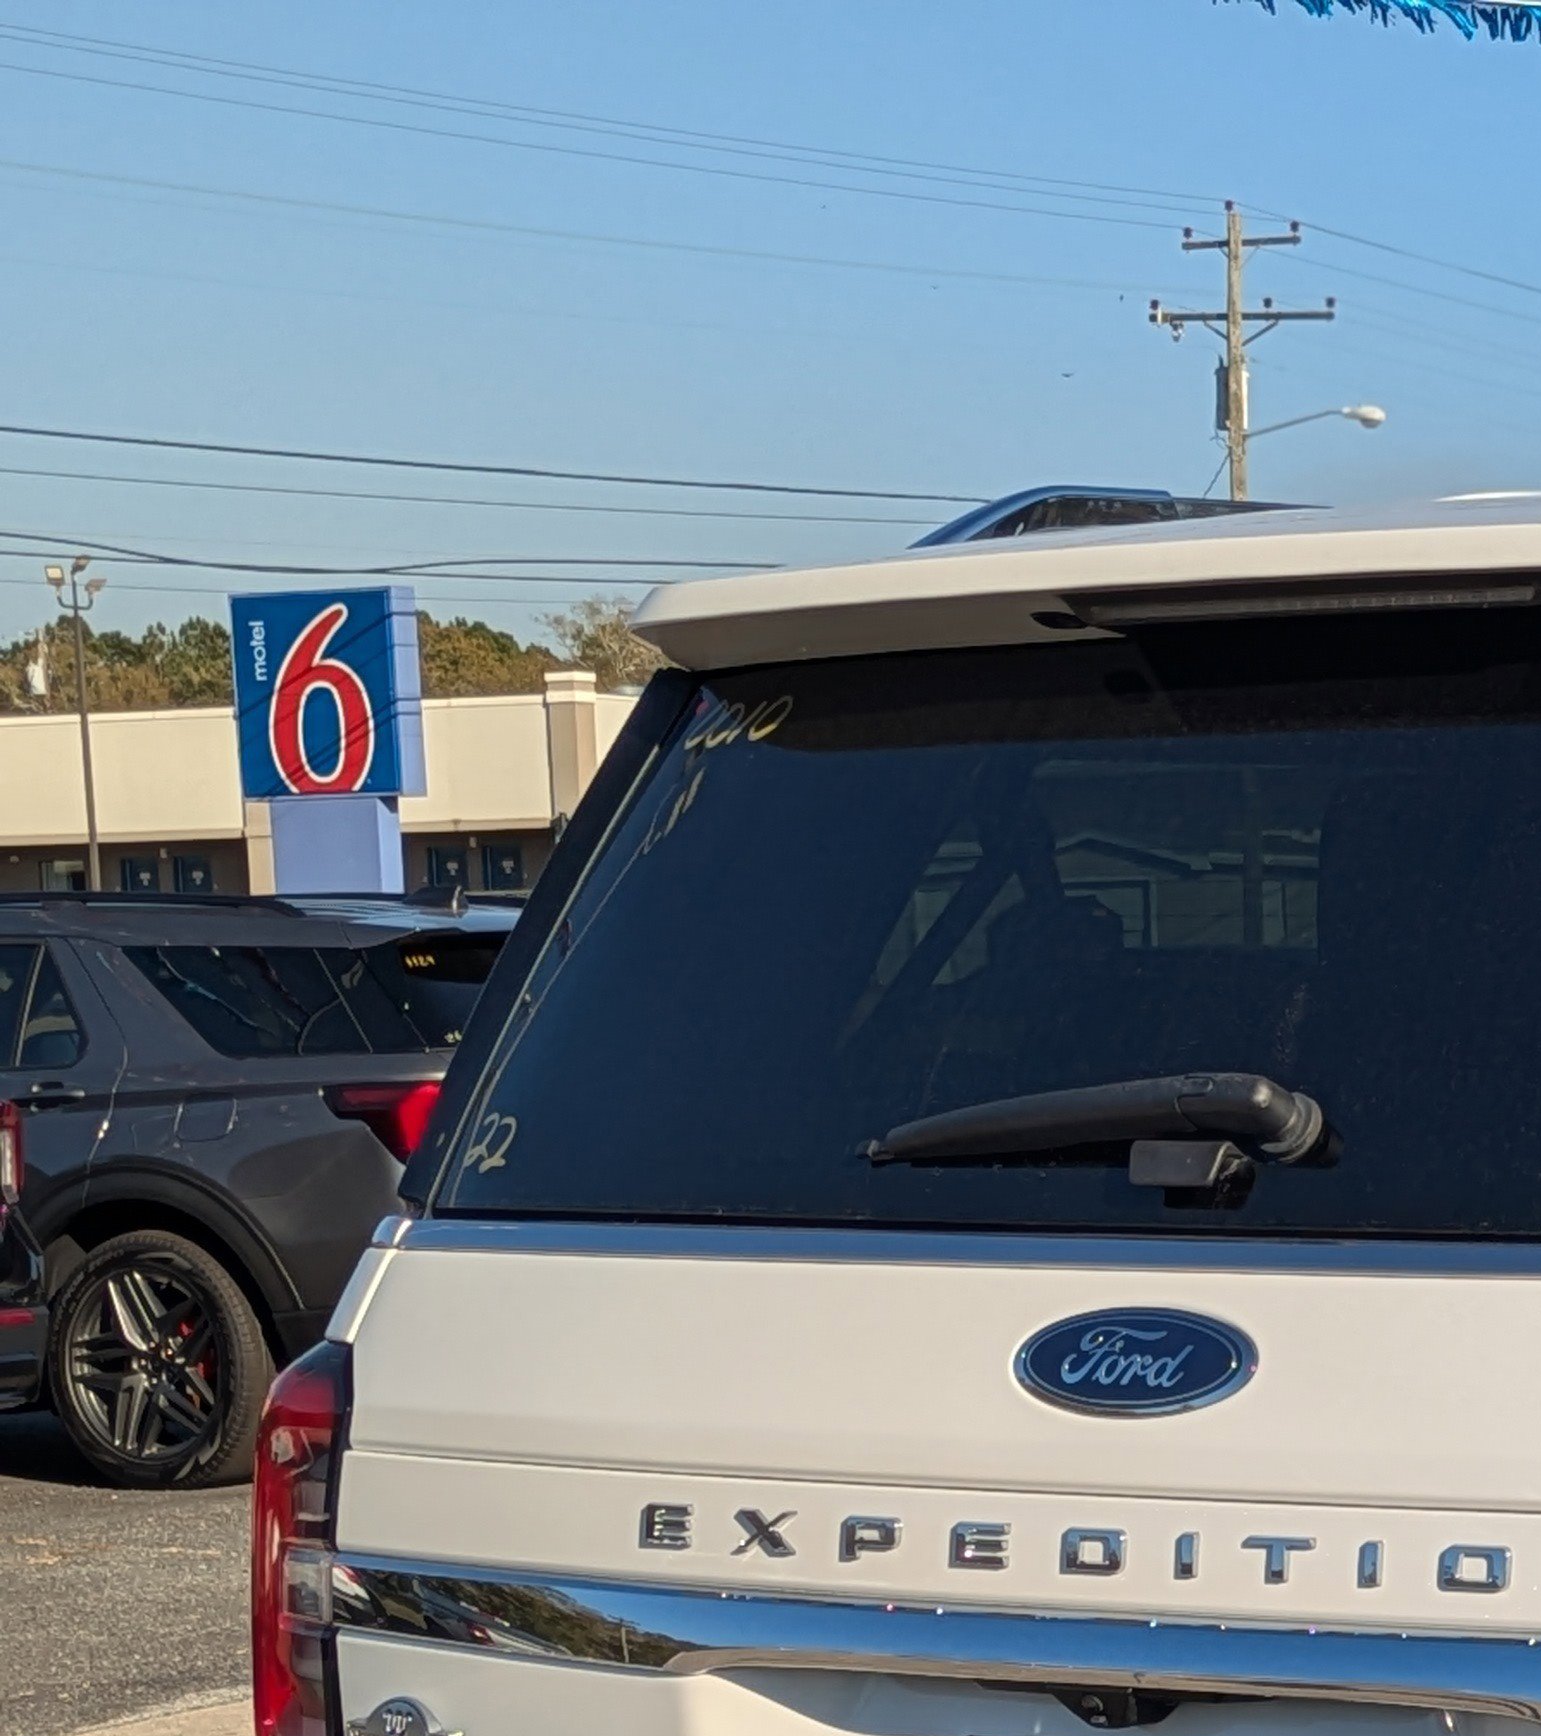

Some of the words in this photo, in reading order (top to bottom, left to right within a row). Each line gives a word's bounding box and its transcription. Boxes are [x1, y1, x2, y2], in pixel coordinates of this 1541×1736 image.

[248, 620, 268, 682] motel
[268, 602, 375, 794] 6
[1061, 1326, 1195, 1388] Ford
